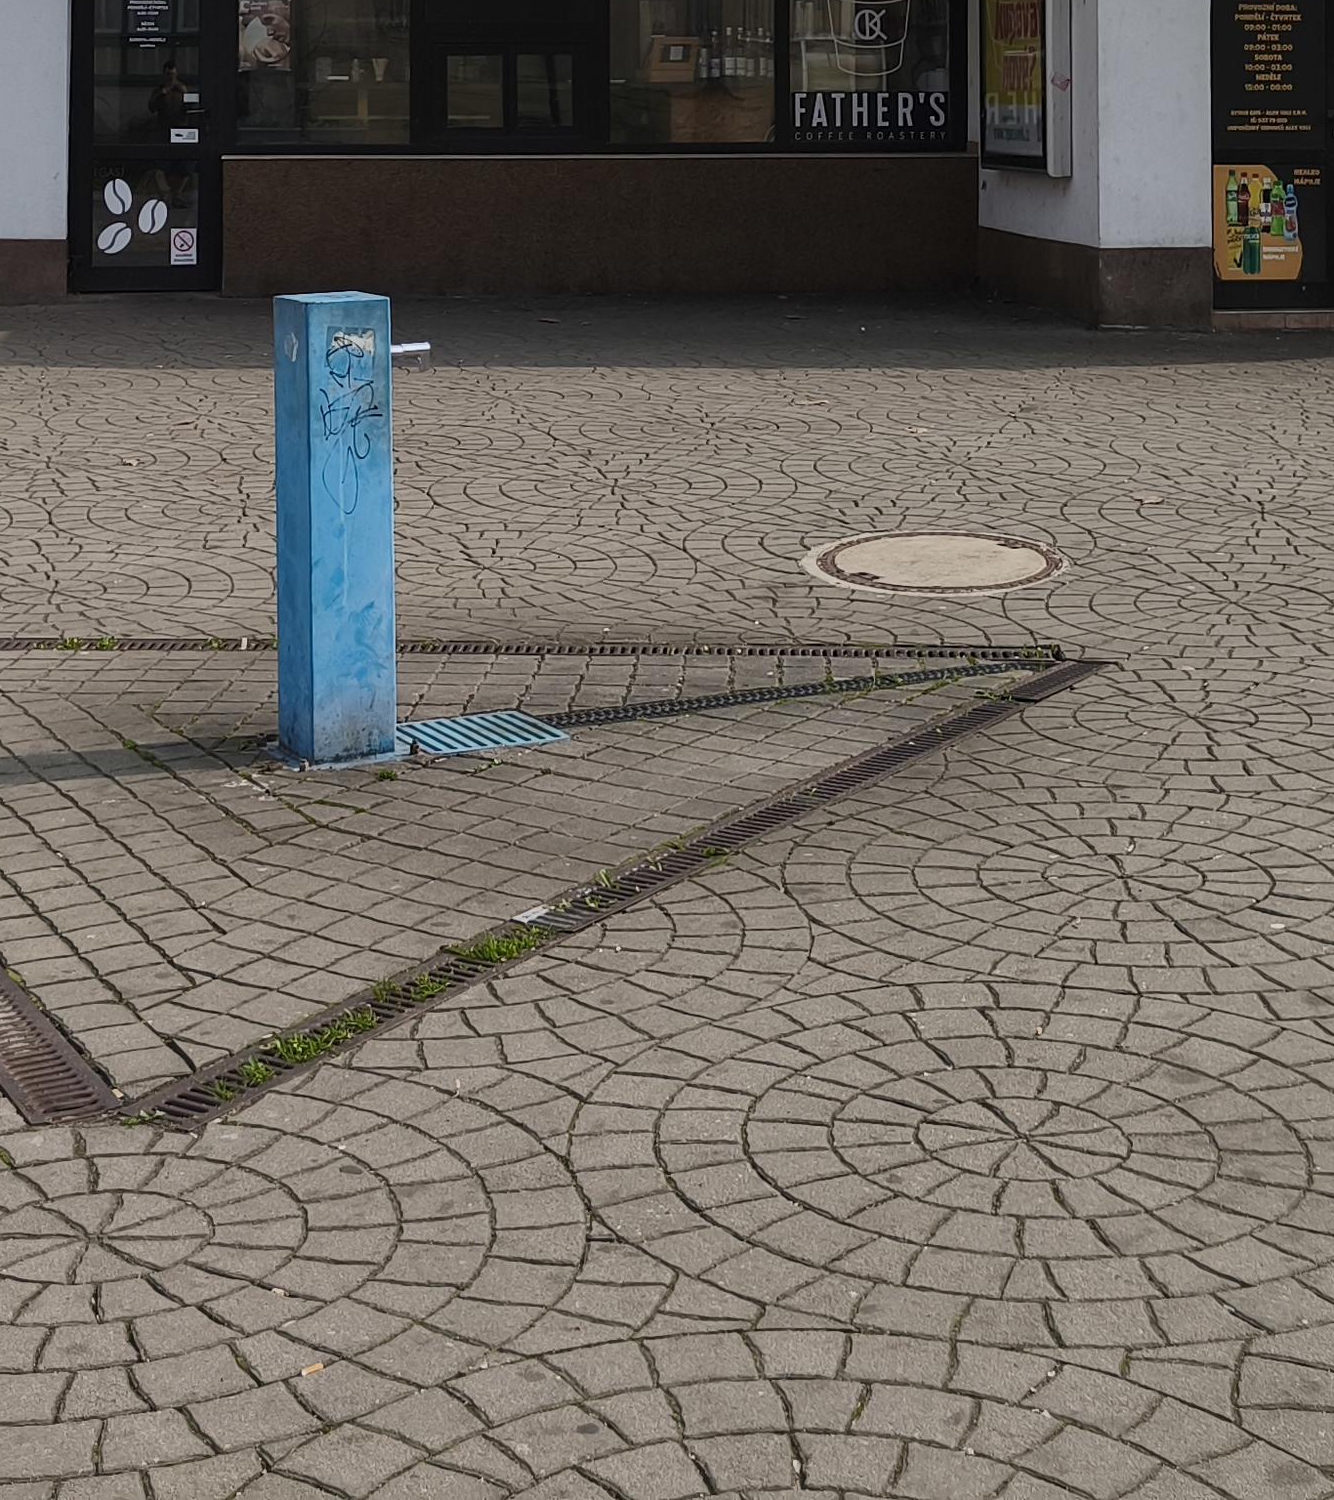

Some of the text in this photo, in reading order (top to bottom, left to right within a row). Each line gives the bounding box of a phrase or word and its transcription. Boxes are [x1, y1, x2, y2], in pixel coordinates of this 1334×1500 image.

[1257, 32, 1280, 41] PÁTEK
[794, 92, 946, 127] FATHER'S
[794, 131, 946, 141] COFFEE ROASTERY
